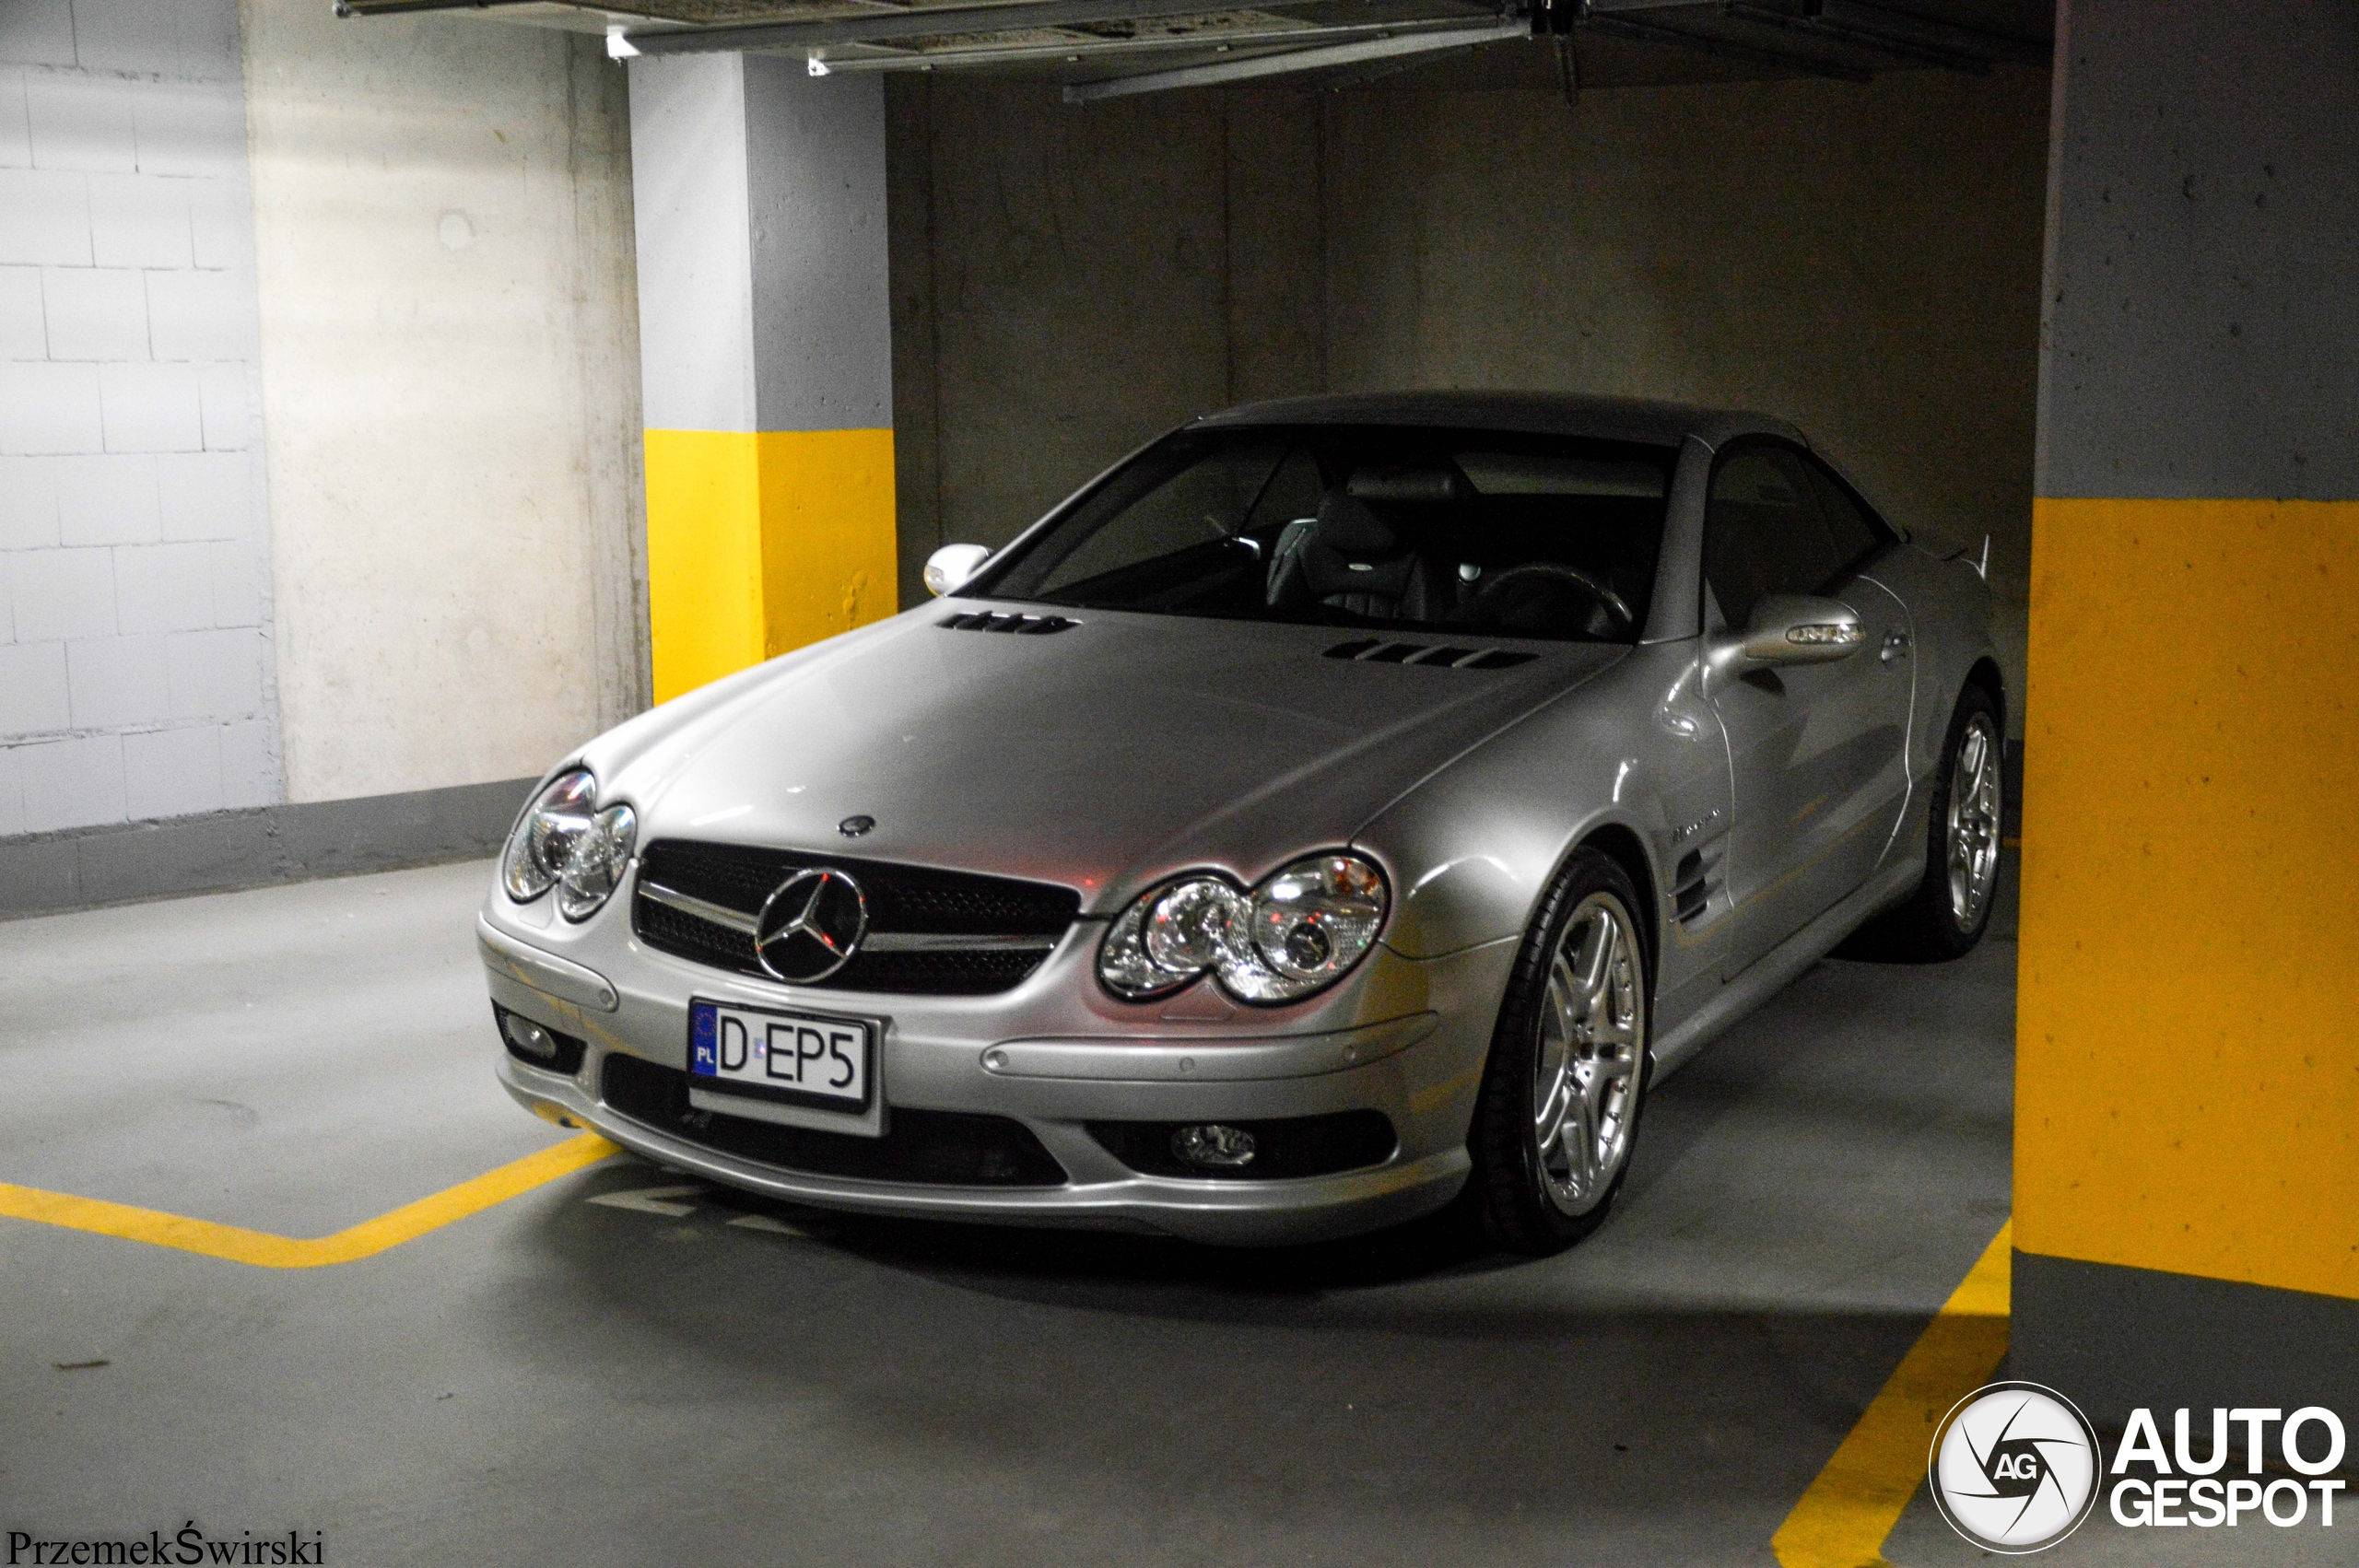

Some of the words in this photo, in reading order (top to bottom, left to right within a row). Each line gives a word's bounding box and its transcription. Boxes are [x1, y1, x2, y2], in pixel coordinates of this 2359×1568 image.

[697, 1046, 714, 1064] PL
[720, 1015, 747, 1071] D
[766, 1022, 853, 1087] EP5
